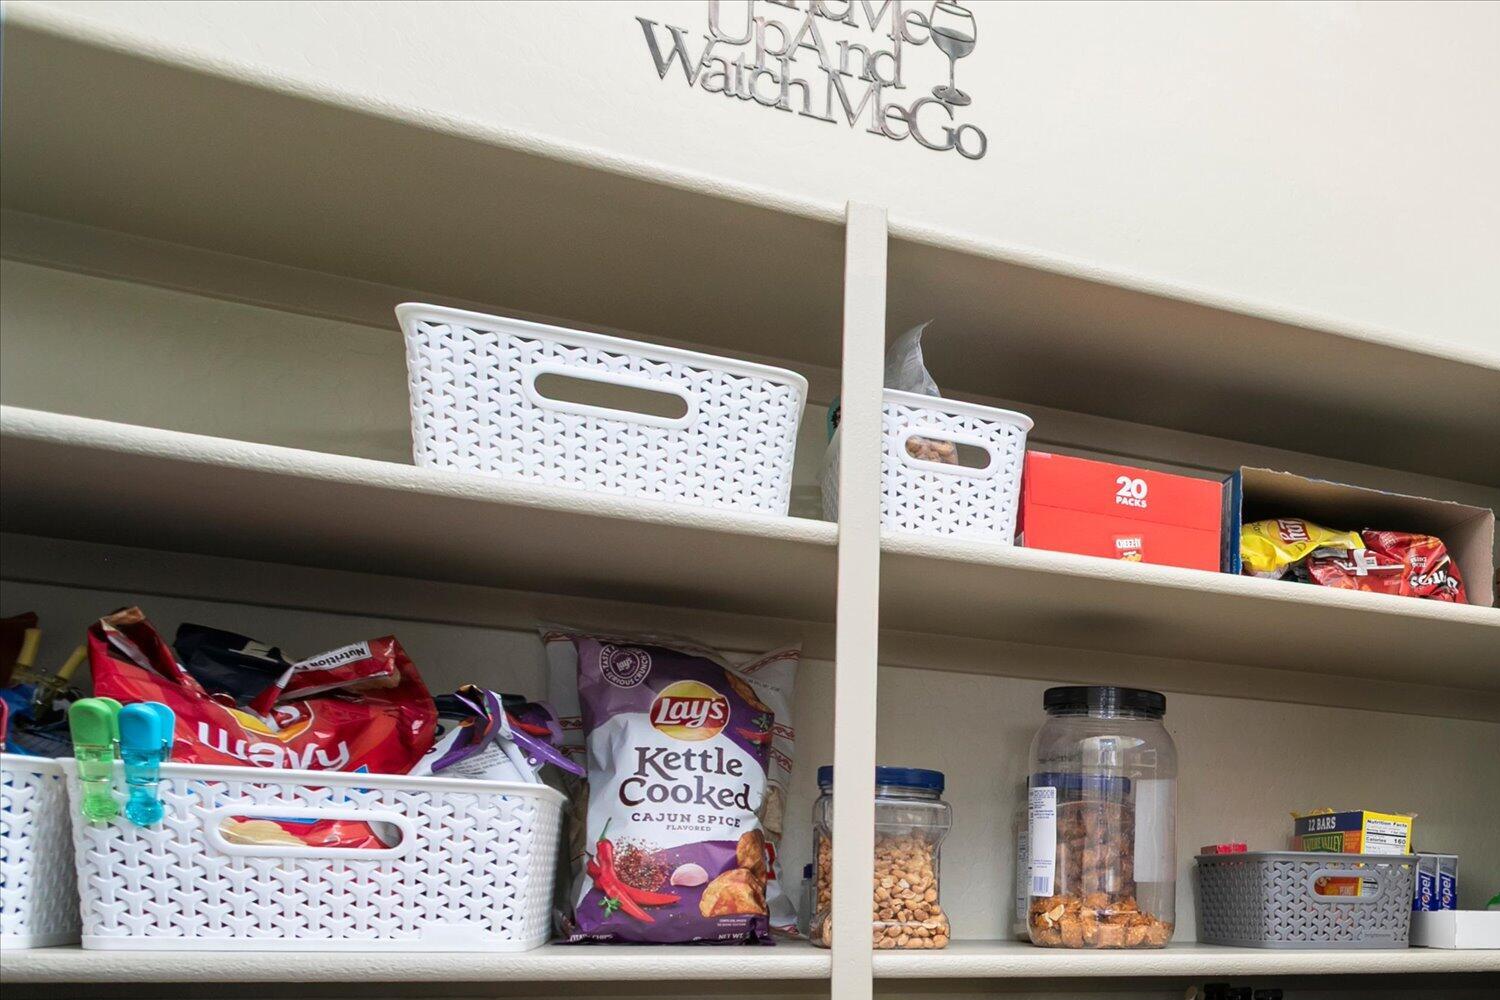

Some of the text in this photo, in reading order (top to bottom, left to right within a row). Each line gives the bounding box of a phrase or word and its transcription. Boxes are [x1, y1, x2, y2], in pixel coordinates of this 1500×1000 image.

[1115, 475, 1148, 500] 20
[1115, 496, 1148, 508] PACKS
[309, 647, 365, 667] Nutrition
[654, 698, 726, 728] Lay's
[633, 746, 743, 782] Kettle
[619, 775, 754, 811] Cooked
[631, 812, 742, 829] CAJUN SPICE
[666, 824, 712, 832] FLAVORED
[1308, 816, 1337, 832] 12 BARS
